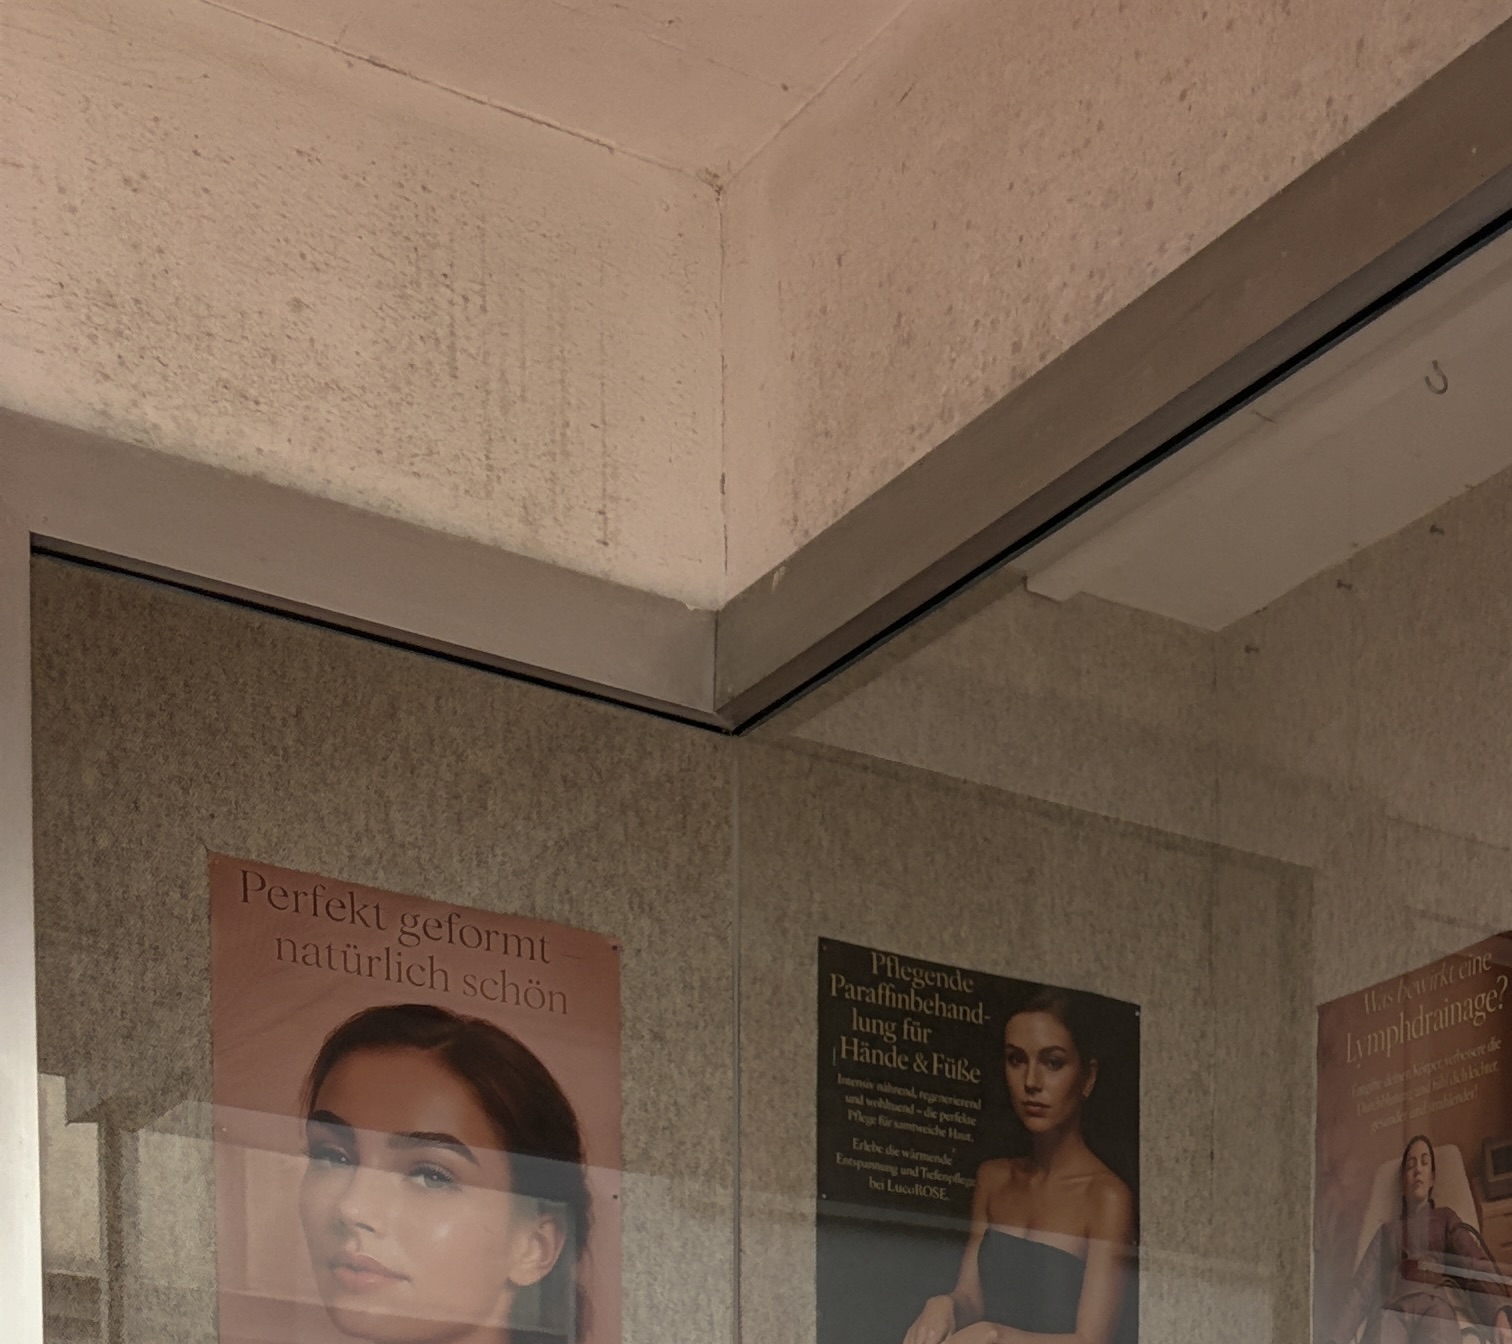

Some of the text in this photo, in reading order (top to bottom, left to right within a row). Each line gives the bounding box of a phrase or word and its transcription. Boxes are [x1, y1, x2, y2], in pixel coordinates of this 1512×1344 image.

[241, 869, 551, 964] Perfekt geformt
[275, 935, 569, 1015] natürlich schön
[871, 952, 974, 993] Pflegende
[1458, 951, 1492, 980] eine
[830, 973, 991, 1025] Paraffinbehand-
[1346, 975, 1508, 1070] Lymphdrainage?
[852, 1007, 932, 1044] lung für
[840, 1036, 981, 1084] Hände & Füße
